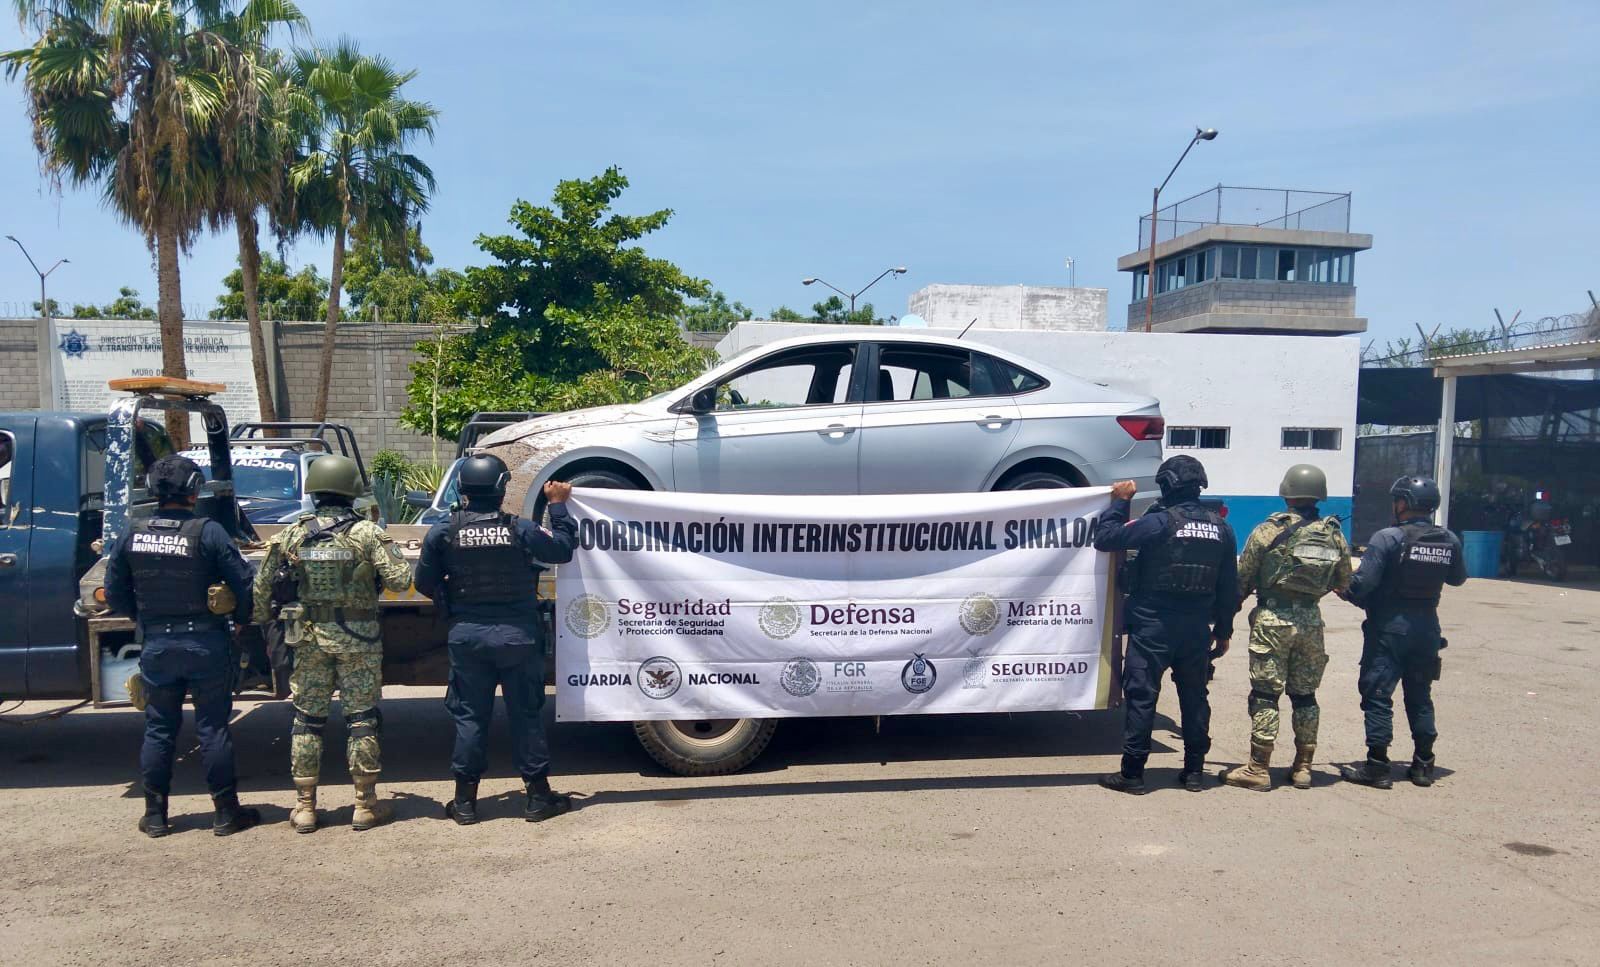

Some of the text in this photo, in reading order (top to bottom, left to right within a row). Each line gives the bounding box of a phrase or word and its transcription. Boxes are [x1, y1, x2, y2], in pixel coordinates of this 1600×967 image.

[459, 536, 511, 546] ESTATAL
[753, 520, 997, 553] INTERINSTITUCIONAL
[1004, 517, 1099, 549] SINALOA
[1176, 529, 1221, 541] ESTATAL
[132, 542, 188, 556] MUNICIPAL
[617, 598, 732, 619] Seguridad
[810, 603, 915, 625] Defensa
[1007, 599, 1082, 617] Marina
[664, 618, 677, 627] de
[678, 619, 725, 629] Seguridad
[1051, 617, 1062, 626] de
[1064, 616, 1094, 625] Marina
[618, 627, 724, 636] y Protección Ciudadana
[849, 628, 858, 636] de
[860, 628, 867, 636] la
[868, 628, 898, 636] Defensa
[900, 627, 933, 635] Nacional
[833, 662, 866, 677] FGR
[991, 661, 1088, 676] SEGURIDAD
[567, 674, 632, 687] GUARDIA
[688, 673, 760, 686] NACIONAL
